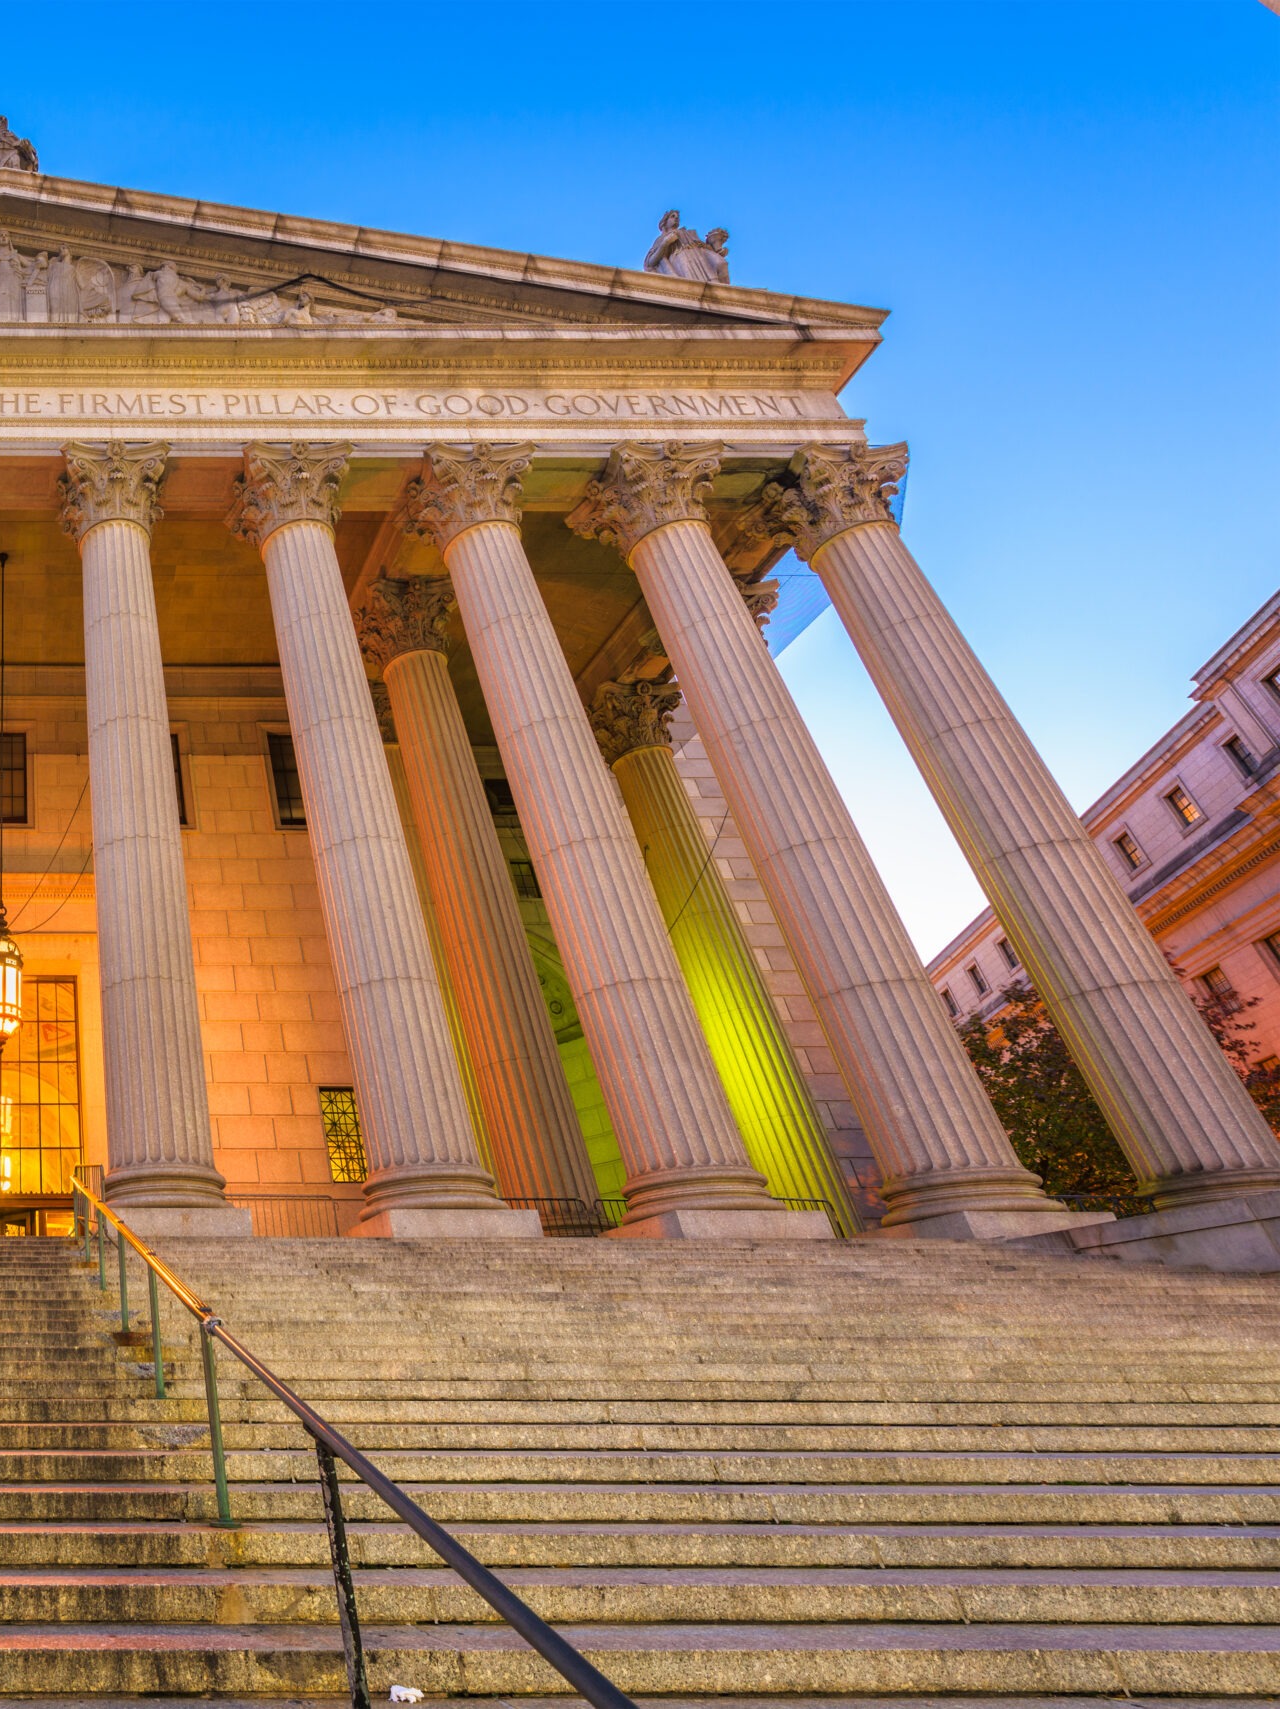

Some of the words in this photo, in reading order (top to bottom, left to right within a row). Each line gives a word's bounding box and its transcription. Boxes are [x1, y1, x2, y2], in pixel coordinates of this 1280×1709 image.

[58, 393, 210, 416] FIRMEST
[224, 394, 342, 416] PILLAR
[350, 394, 404, 416] OF
[414, 394, 530, 416] GOOD
[543, 394, 807, 417] GOVERNMENT
